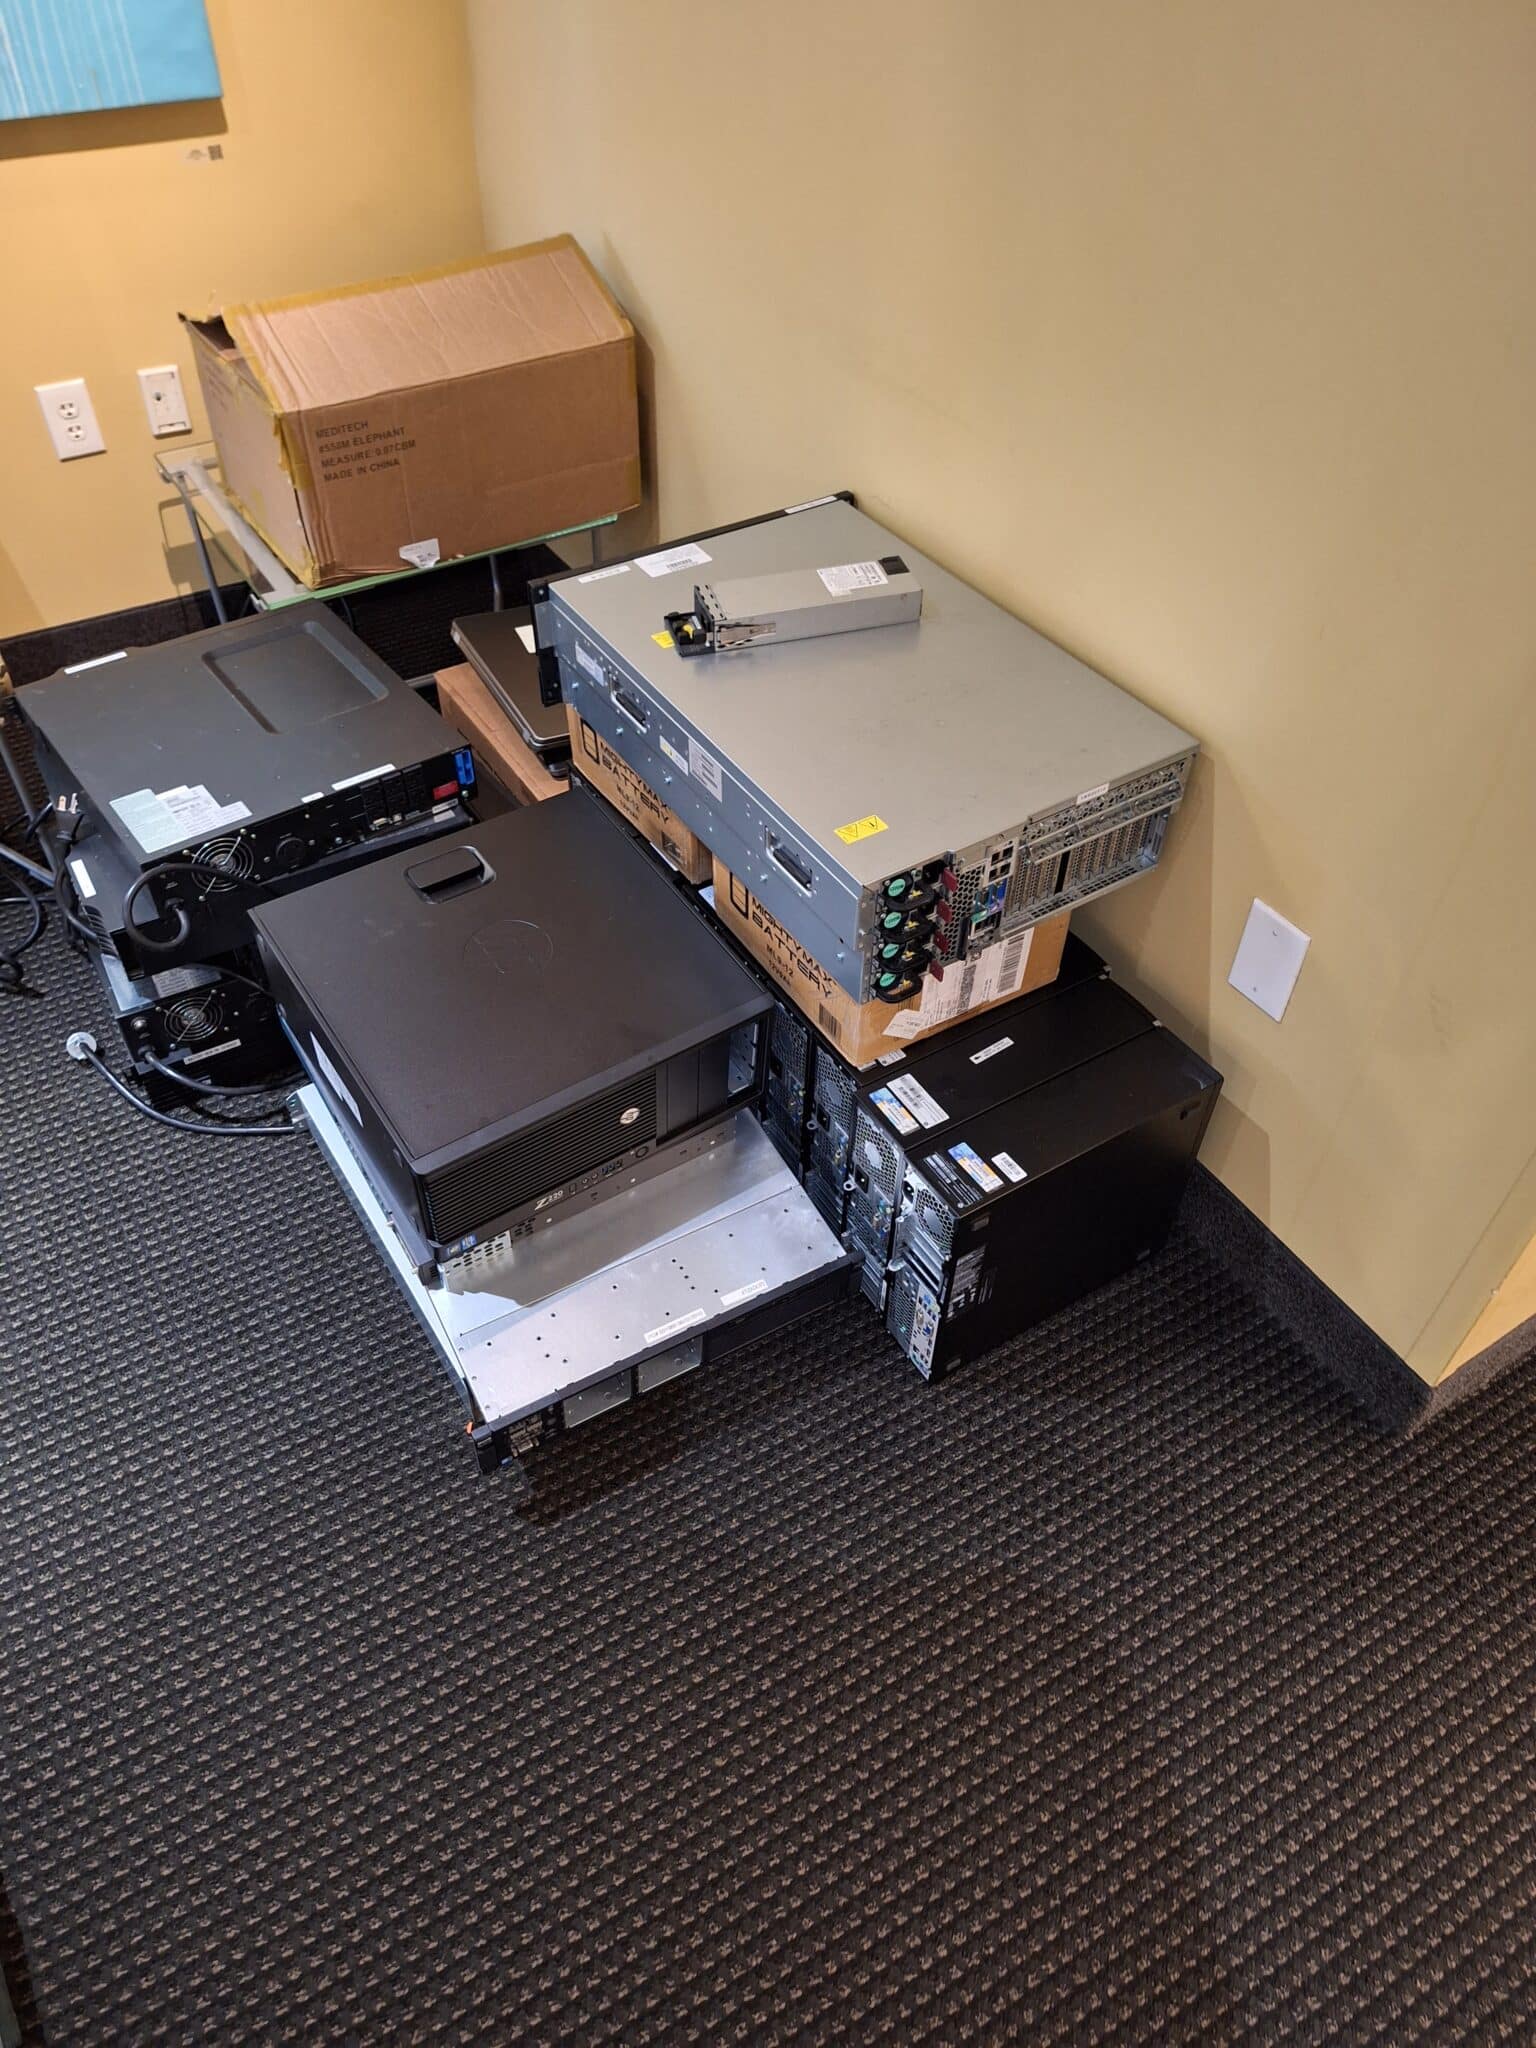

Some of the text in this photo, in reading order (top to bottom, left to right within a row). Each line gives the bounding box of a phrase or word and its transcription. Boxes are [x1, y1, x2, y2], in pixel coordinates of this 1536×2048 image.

[315, 420, 369, 439] MEDITECH
[352, 426, 405, 447] ELEPHANT
[323, 458, 400, 482] MADE IN CHINA
[602, 754, 669, 824] BATTERY
[752, 896, 832, 987] MIGHTYMAX
[752, 911, 831, 998] BATTERY
